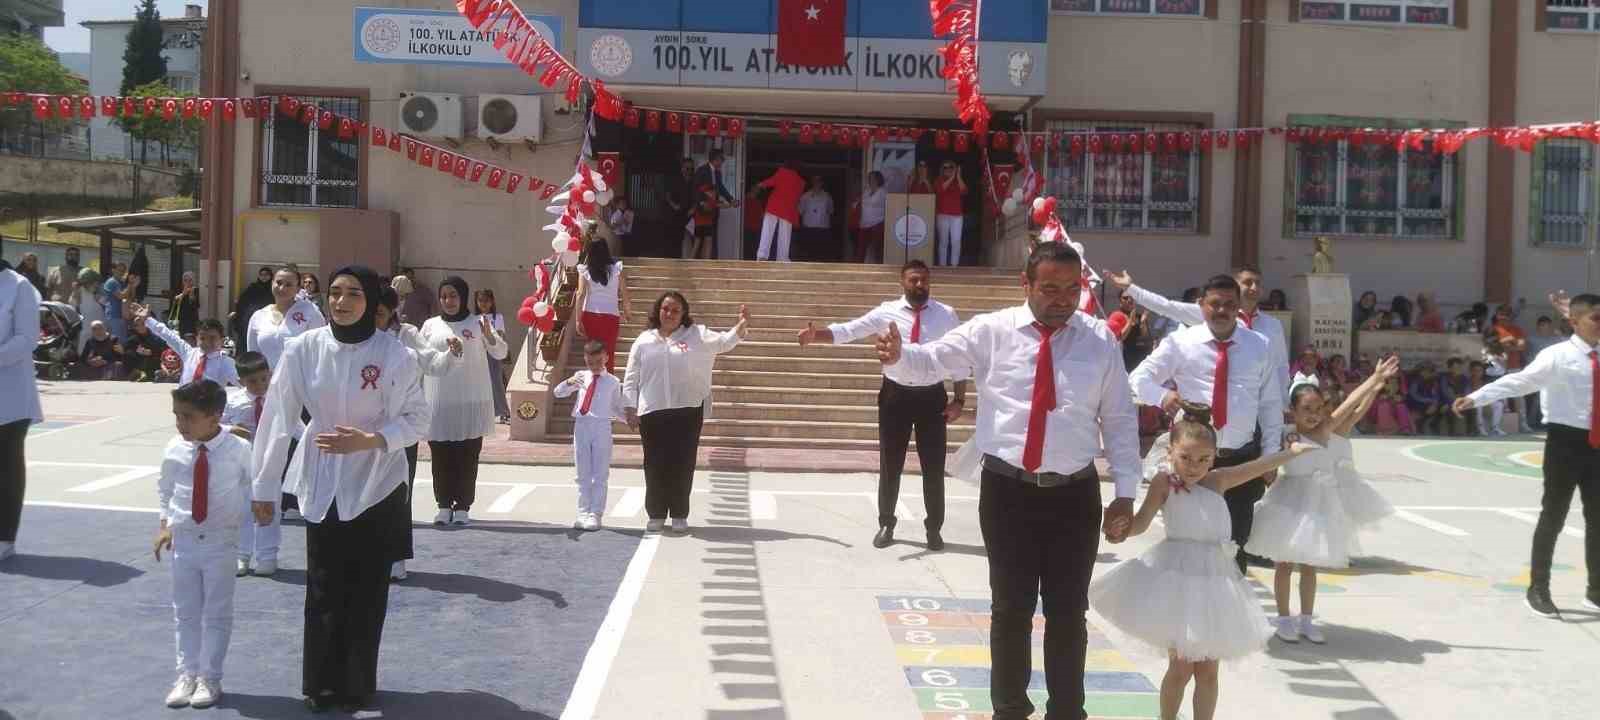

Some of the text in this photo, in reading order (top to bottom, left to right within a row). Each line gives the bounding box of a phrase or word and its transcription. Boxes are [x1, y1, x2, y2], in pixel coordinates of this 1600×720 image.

[410, 28, 434, 40] 100.
[438, 29, 456, 41] YIL
[408, 39, 472, 56] İLKOKULU
[896, 598, 941, 611] 10
[900, 613, 929, 626] 9
[905, 630, 937, 644] 8
[911, 649, 941, 664] 7
[921, 669, 957, 687] 6
[934, 692, 970, 710] 5
